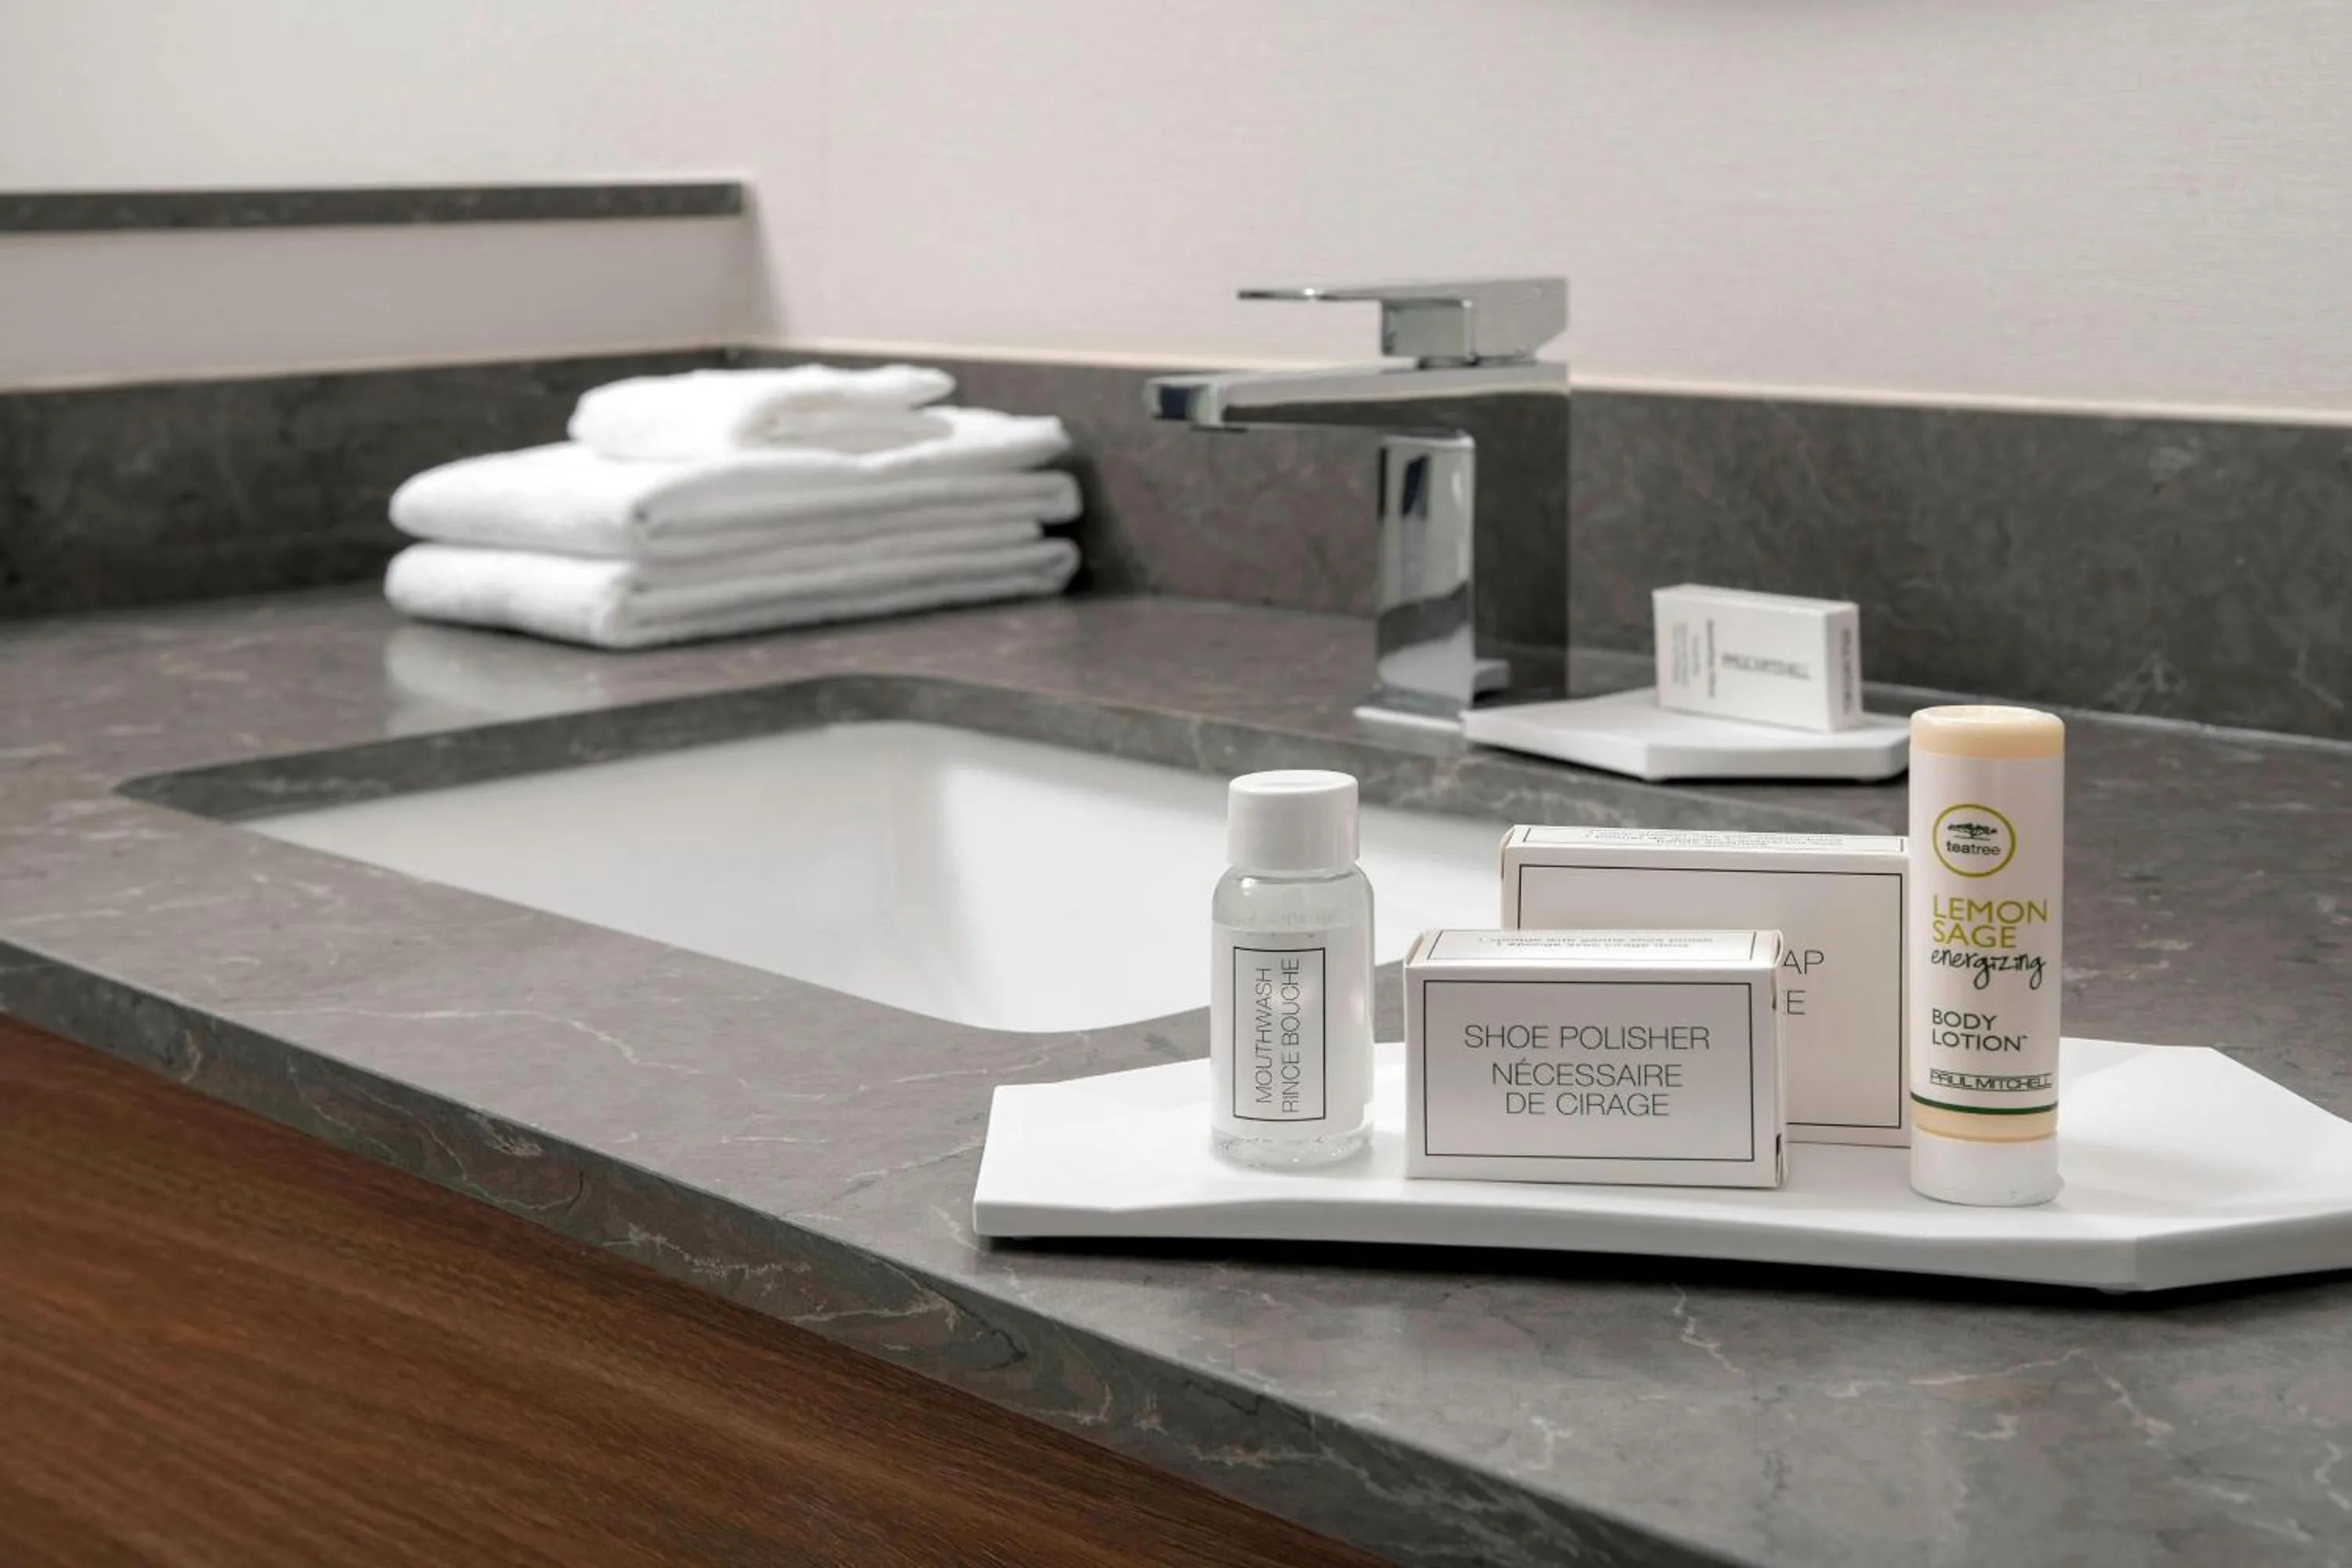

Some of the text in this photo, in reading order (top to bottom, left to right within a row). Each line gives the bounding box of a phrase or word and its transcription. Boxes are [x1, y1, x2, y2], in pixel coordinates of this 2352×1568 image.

[1933, 895, 2048, 924] LEMON
[1933, 920, 2017, 948] SAGE
[1782, 949, 1824, 975] AP
[1931, 948, 2046, 991] energizing
[1932, 1007, 1998, 1031] BODY
[1254, 968, 1272, 1104] MOUTHWASH
[1281, 958, 1300, 1113] RINCE BOUCHE
[1464, 1024, 1709, 1050] SHOE POLISHER
[1933, 1028, 2022, 1051] LOTION
[1492, 1058, 1682, 1087] NÉCESSAIRE
[1506, 1092, 1669, 1117] DE CIRAGE
